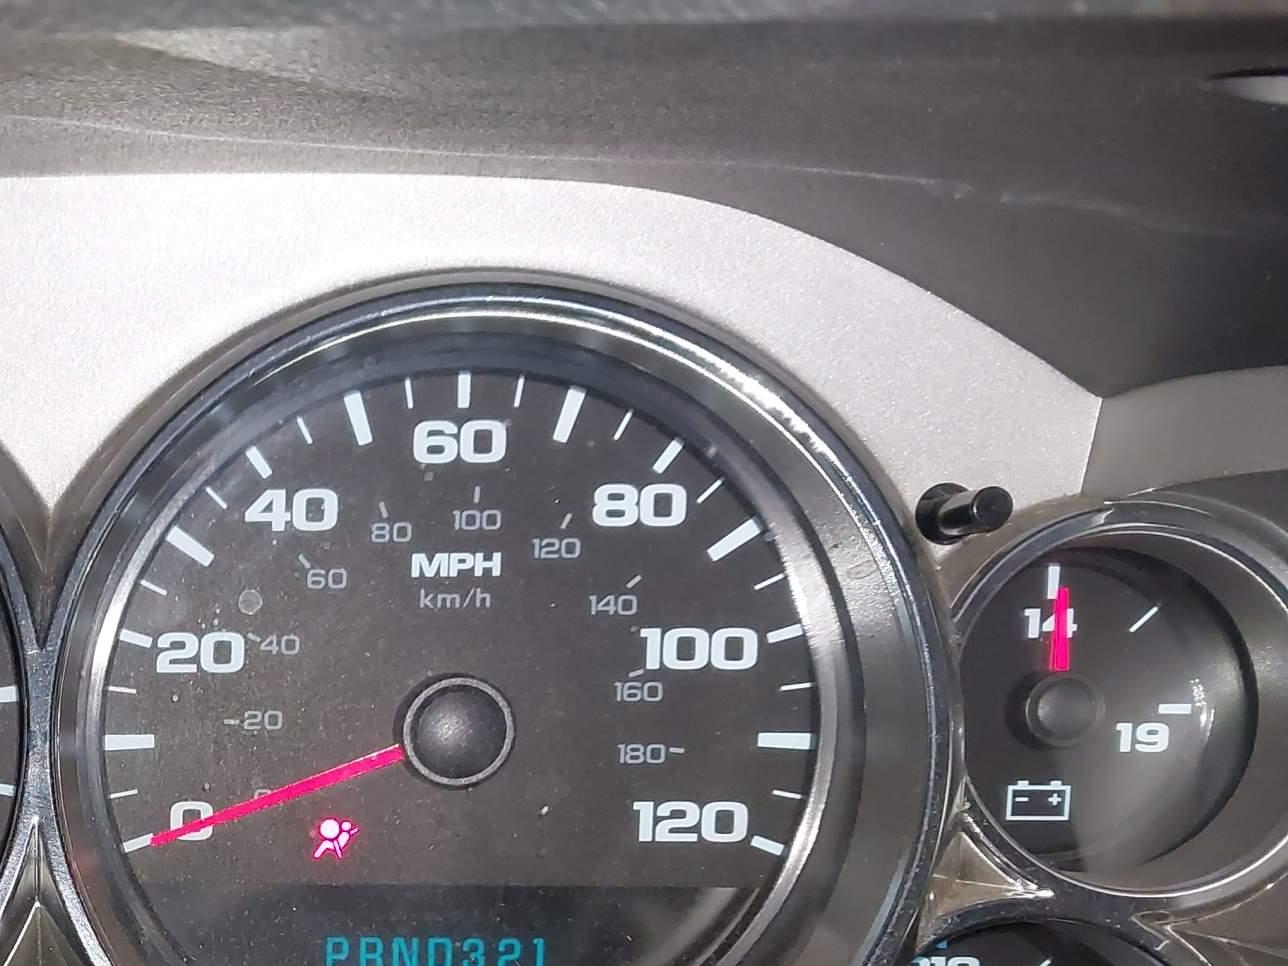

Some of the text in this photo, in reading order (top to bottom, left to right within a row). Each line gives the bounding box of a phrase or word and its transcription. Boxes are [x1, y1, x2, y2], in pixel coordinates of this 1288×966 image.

[412, 419, 507, 464] 60
[244, 488, 339, 532] 40
[592, 483, 687, 527] 80
[452, 509, 502, 531] 100
[370, 521, 413, 544] 80
[531, 537, 582, 560] 120
[410, 551, 502, 578] MPH
[305, 567, 348, 590] 60
[419, 587, 492, 609] km/h
[588, 594, 638, 616] 140
[155, 631, 245, 675] 20
[259, 633, 301, 655] 40
[638, 627, 759, 670] 100
[614, 681, 663, 702] 160
[242, 710, 284, 731] 20
[1116, 722, 1170, 753] 19
[617, 743, 666, 764] 180
[169, 800, 214, 842] 0
[632, 801, 749, 843] 120
